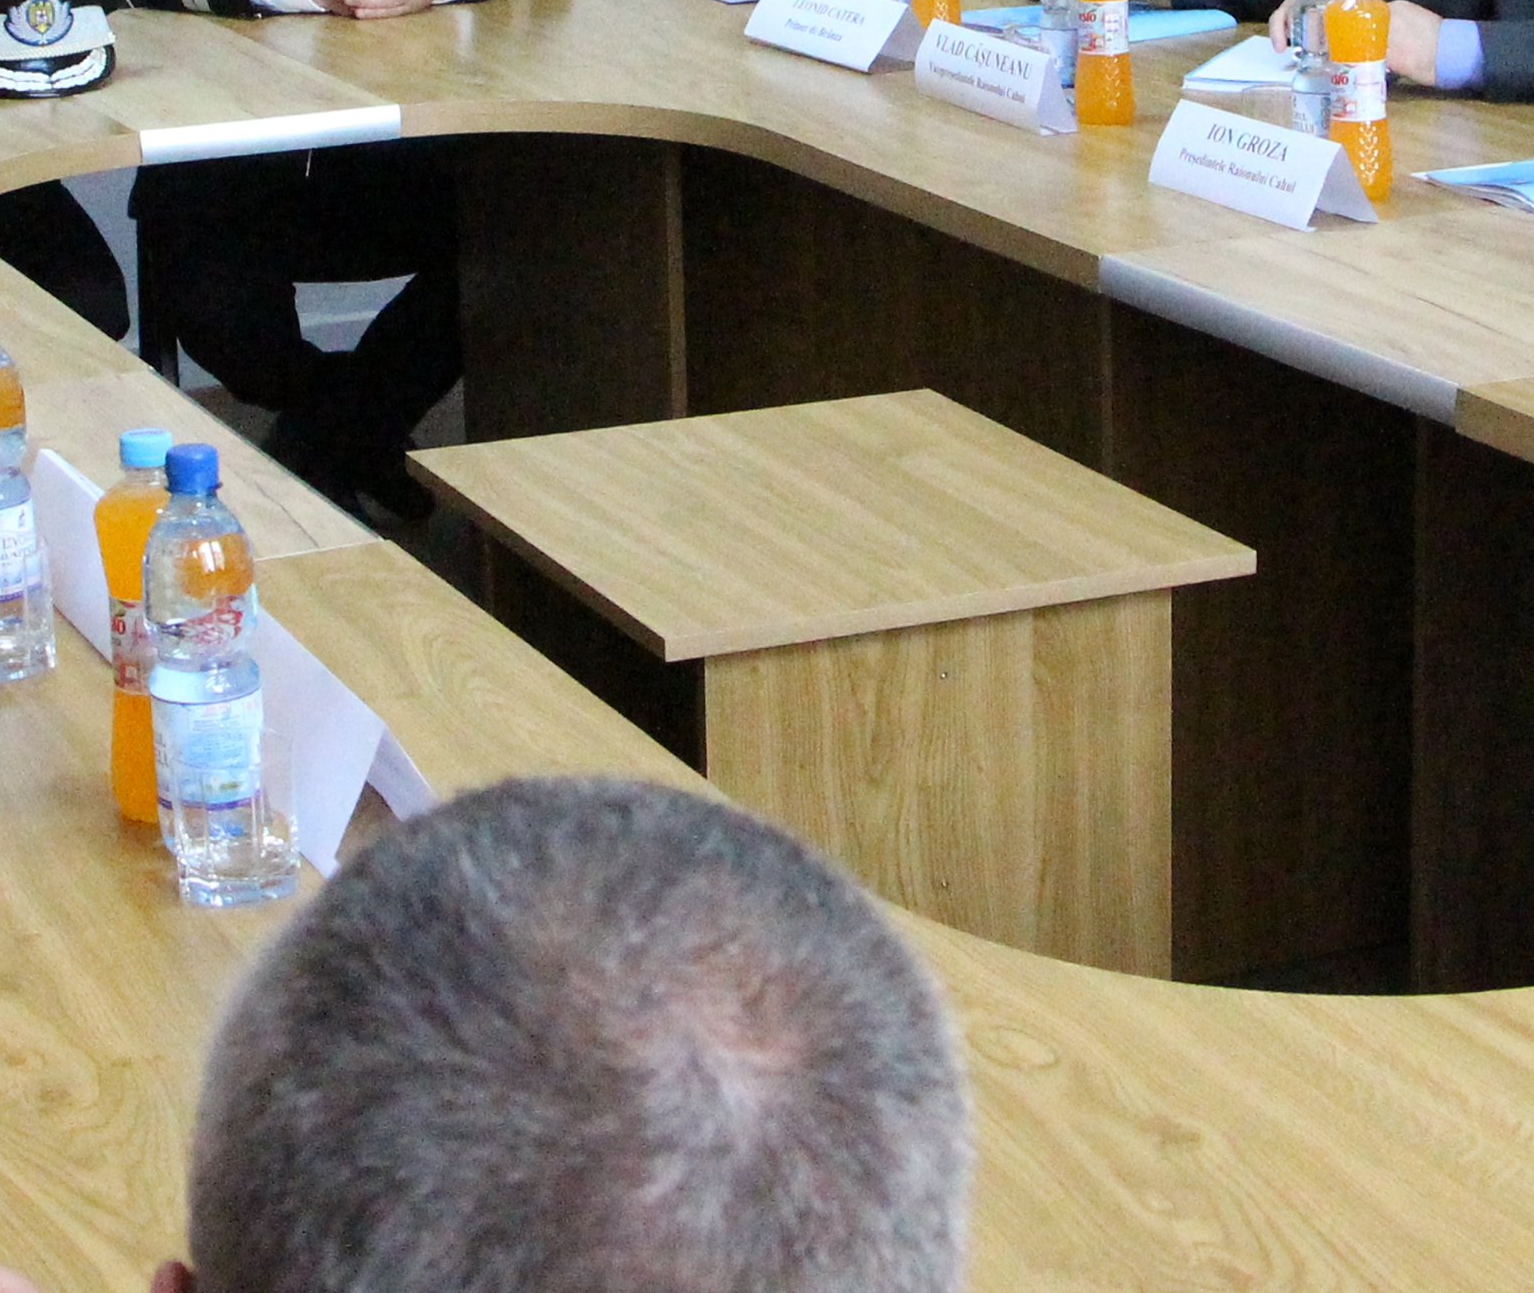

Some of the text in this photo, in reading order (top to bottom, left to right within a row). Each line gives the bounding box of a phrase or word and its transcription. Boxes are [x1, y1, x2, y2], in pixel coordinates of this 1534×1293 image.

[935, 33, 965, 57] VLAD
[1206, 123, 1289, 162] ION GROZA
[1227, 161, 1270, 186] Raionului
[1268, 174, 1297, 194] Cahul
